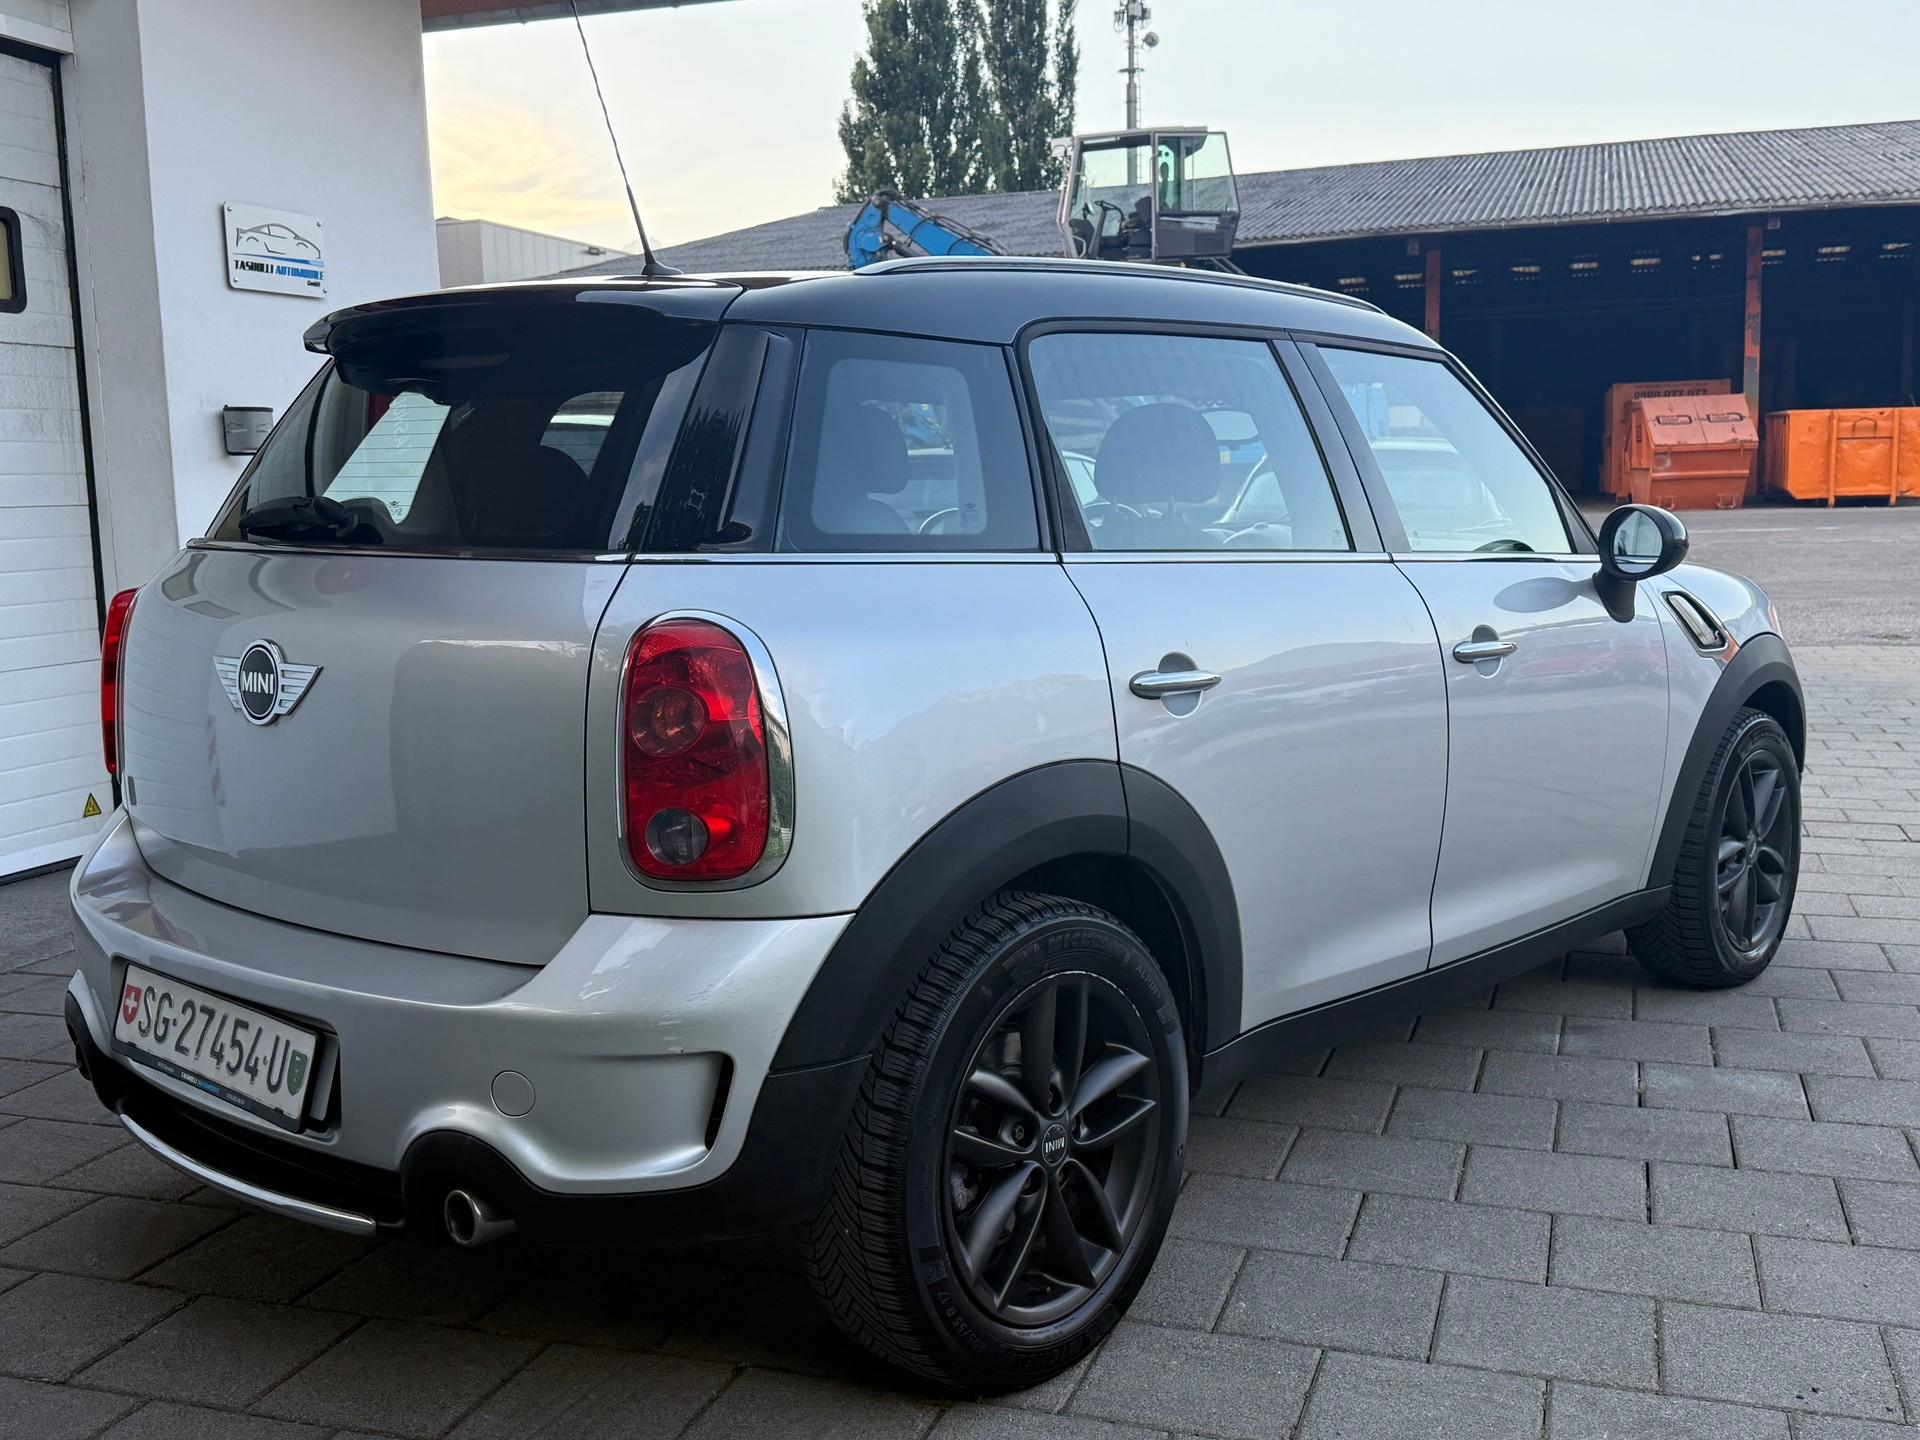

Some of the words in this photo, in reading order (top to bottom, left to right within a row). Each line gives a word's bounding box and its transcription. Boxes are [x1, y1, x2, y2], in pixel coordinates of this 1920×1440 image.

[275, 265, 324, 280] AUTOMOBILE
[242, 670, 274, 695] MINI
[1045, 1136, 1065, 1153] MINI
